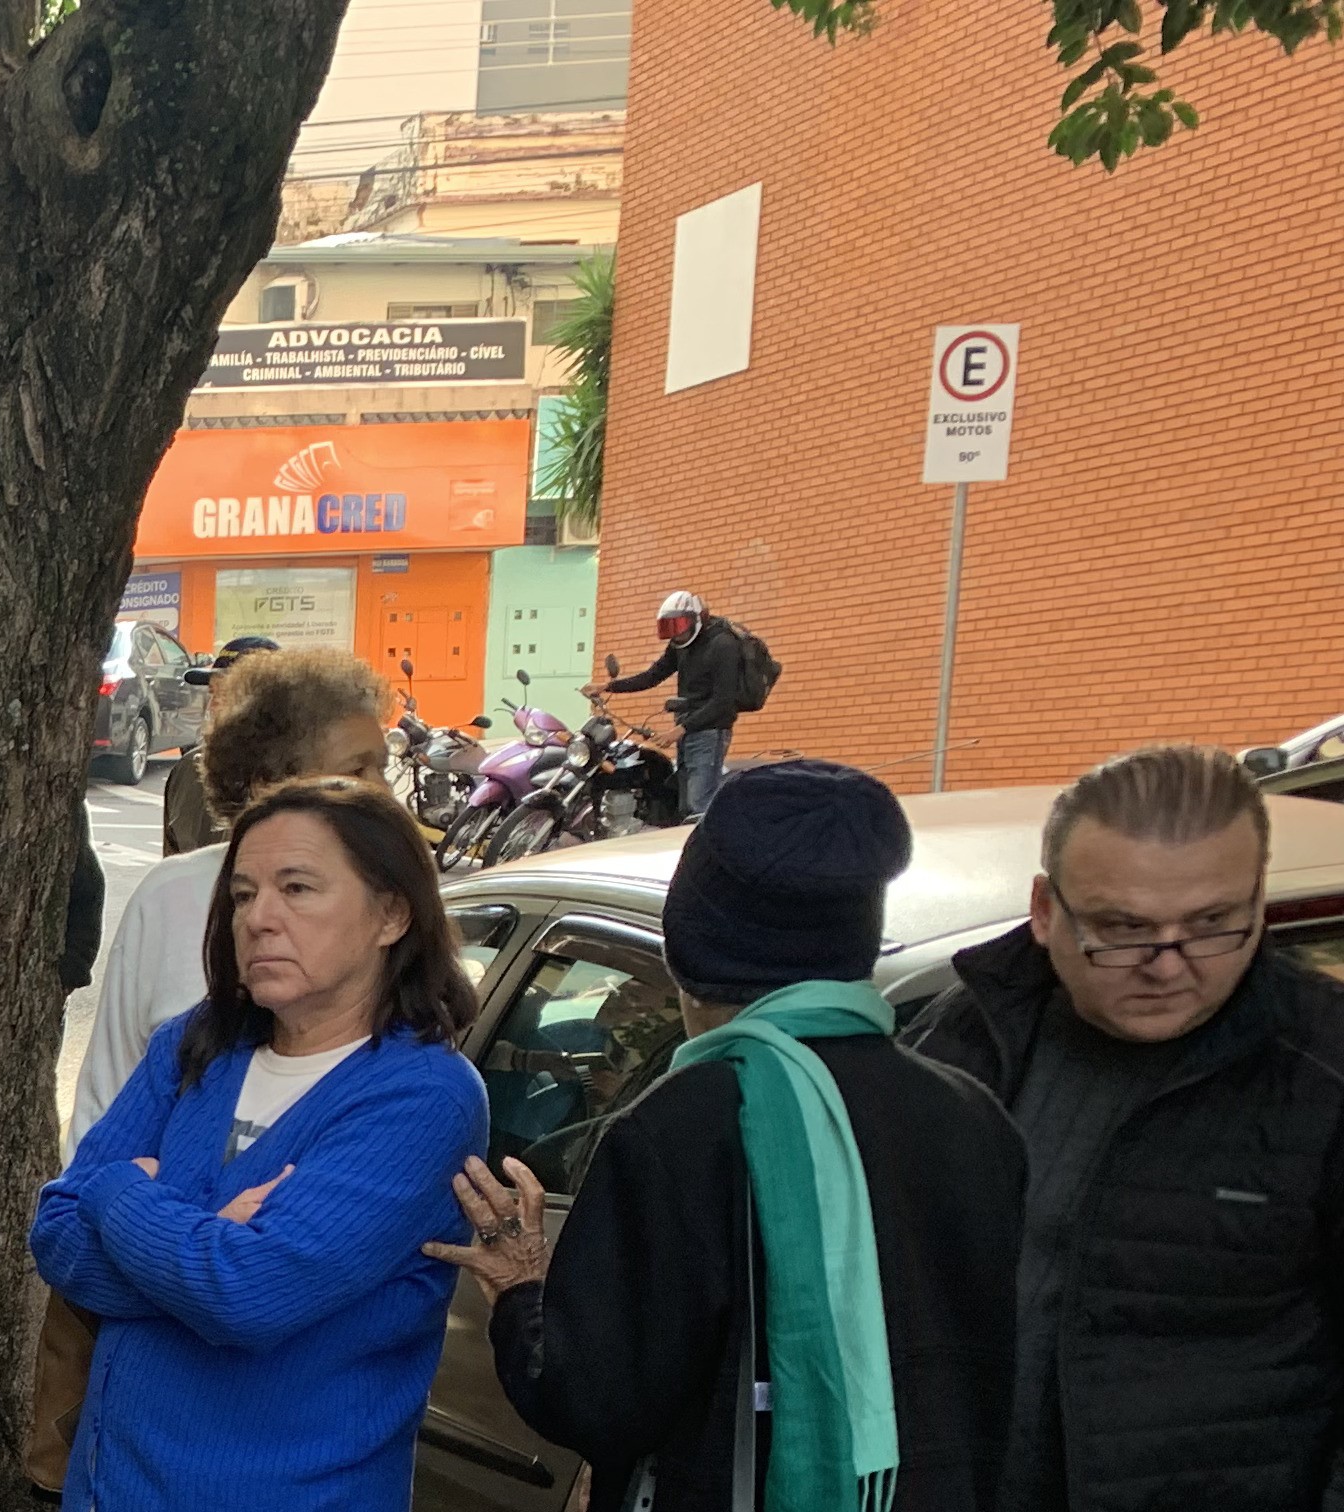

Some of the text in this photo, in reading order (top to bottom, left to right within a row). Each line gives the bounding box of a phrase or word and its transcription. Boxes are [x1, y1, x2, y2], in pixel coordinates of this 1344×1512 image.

[268, 326, 443, 348] ADVOCACIA
[211, 350, 253, 367] AMILÍA
[265, 349, 345, 365] TRABALHISTA
[357, 345, 458, 361] PREVIDENCIÁRIO
[470, 343, 505, 360] CÍVEL
[242, 366, 302, 381] CRIMINAL
[314, 364, 382, 379] AMBIENTAL
[394, 360, 466, 376] TRIBUTÁRIO
[963, 346, 987, 386] E
[933, 411, 1007, 424] EXCLUSIVO
[946, 425, 993, 437] MOTOS
[193, 492, 406, 539] GRANACRED
[125, 580, 168, 595] CRÉDITO
[120, 593, 180, 609] ONSIGNADO
[254, 595, 315, 612] FGTS
